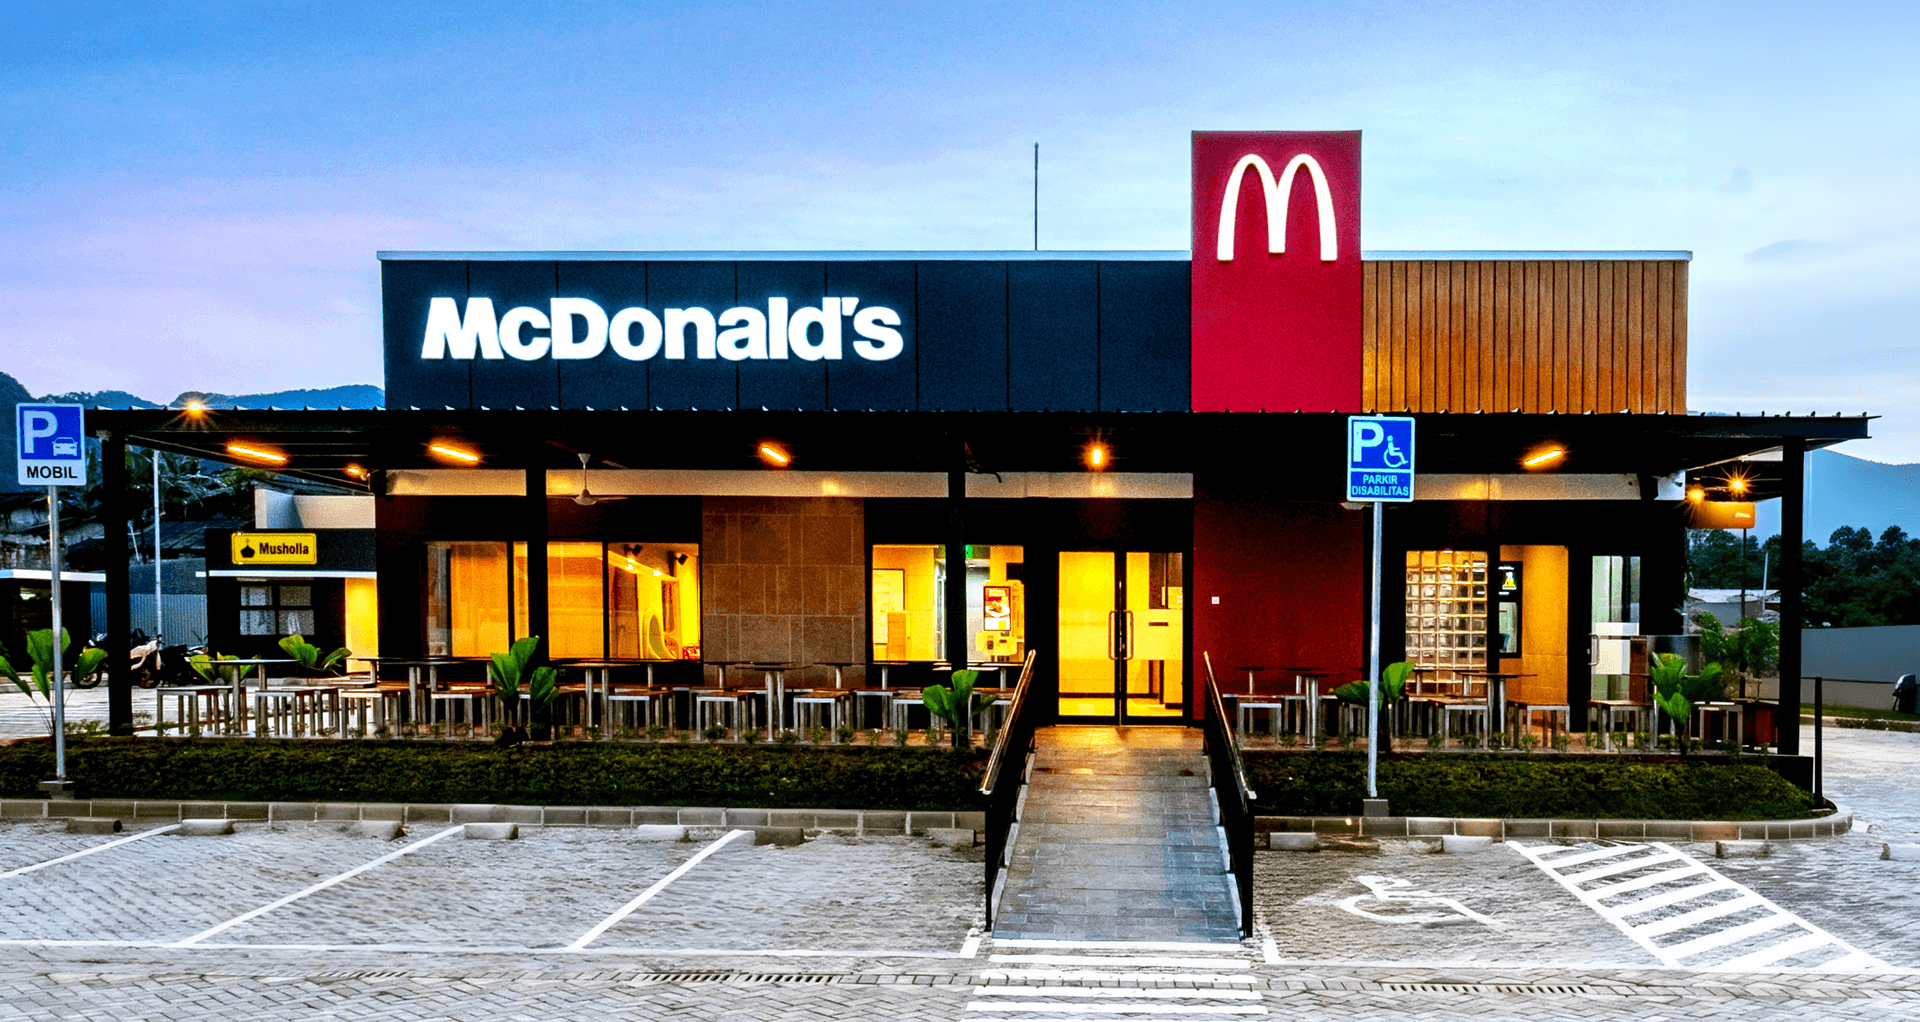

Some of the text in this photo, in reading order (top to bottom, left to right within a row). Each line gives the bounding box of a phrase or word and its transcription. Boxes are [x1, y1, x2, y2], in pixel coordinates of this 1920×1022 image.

[420, 297, 904, 361] McDonald's
[23, 410, 58, 454] P
[1353, 421, 1384, 462] P
[26, 465, 78, 479] MOBIL
[1362, 474, 1398, 485] PARKIR
[1351, 485, 1409, 496] DISABILITAS
[258, 541, 310, 555] Musholla
